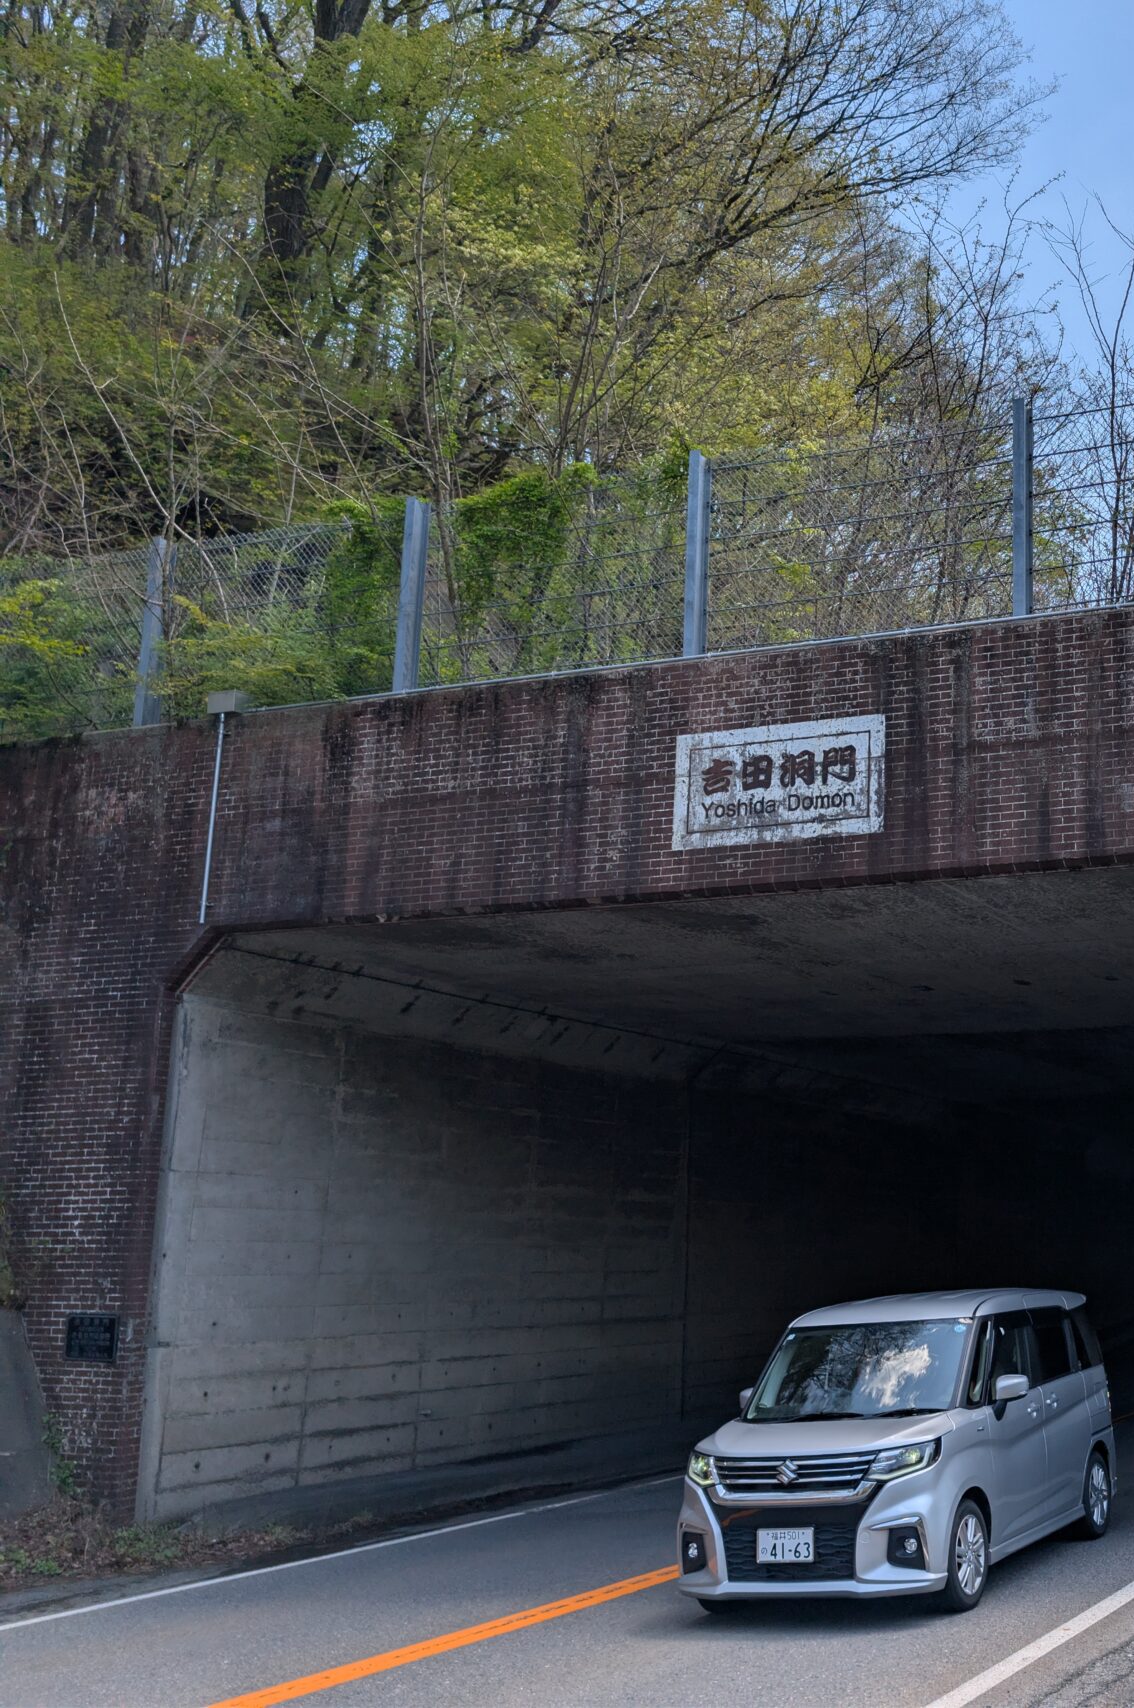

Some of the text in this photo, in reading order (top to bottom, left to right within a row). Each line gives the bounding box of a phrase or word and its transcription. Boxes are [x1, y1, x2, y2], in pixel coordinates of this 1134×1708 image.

[702, 745, 857, 796] 吉田洞門
[701, 792, 855, 819] Yoshida Domon
[770, 1542, 811, 1559] 41-63
